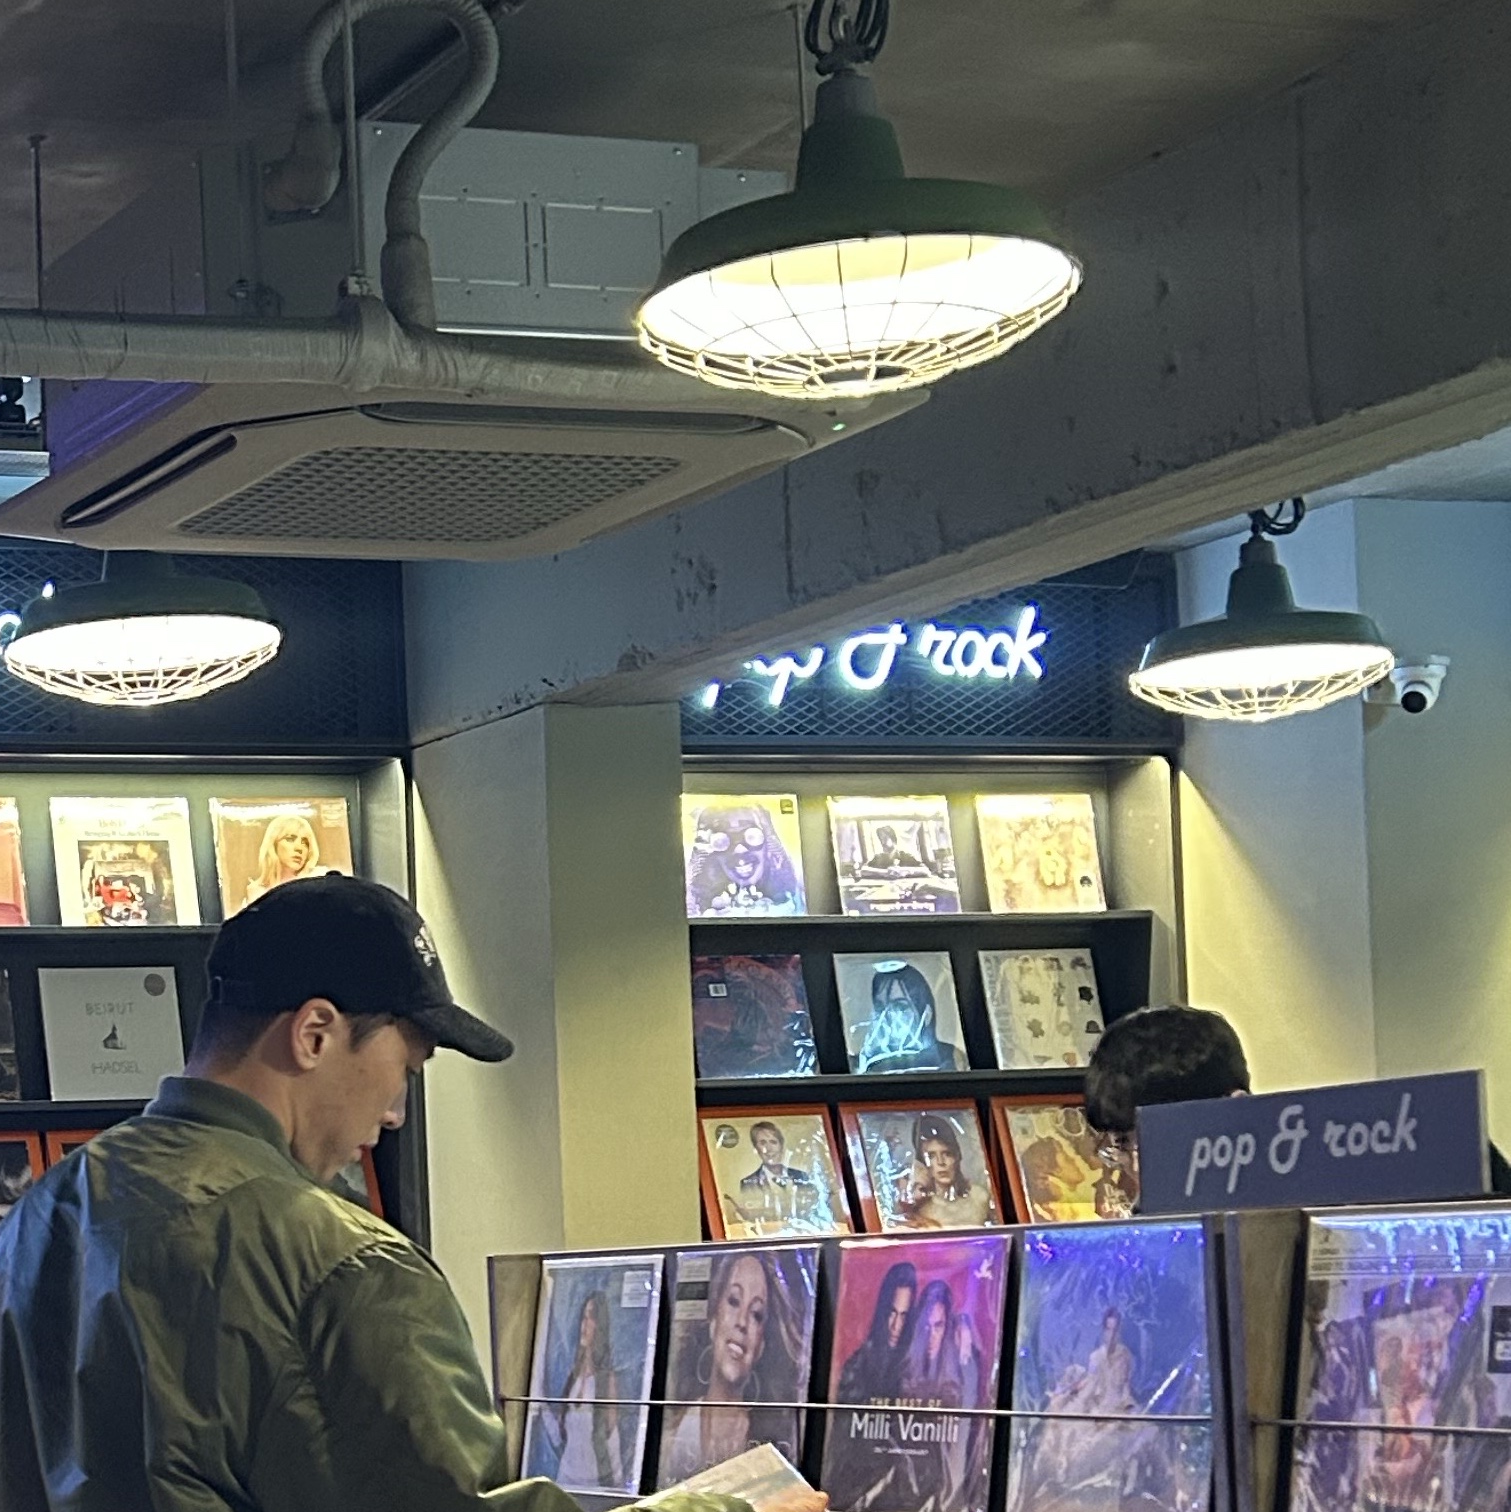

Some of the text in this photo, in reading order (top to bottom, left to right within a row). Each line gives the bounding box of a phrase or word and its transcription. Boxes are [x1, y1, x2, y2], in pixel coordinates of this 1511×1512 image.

[918, 603, 1048, 681] rock
[85, 1002, 135, 1016] BEIRUT
[1185, 1093, 1418, 1197] pop & rock
[849, 1411, 959, 1442] Milli Vanilli
